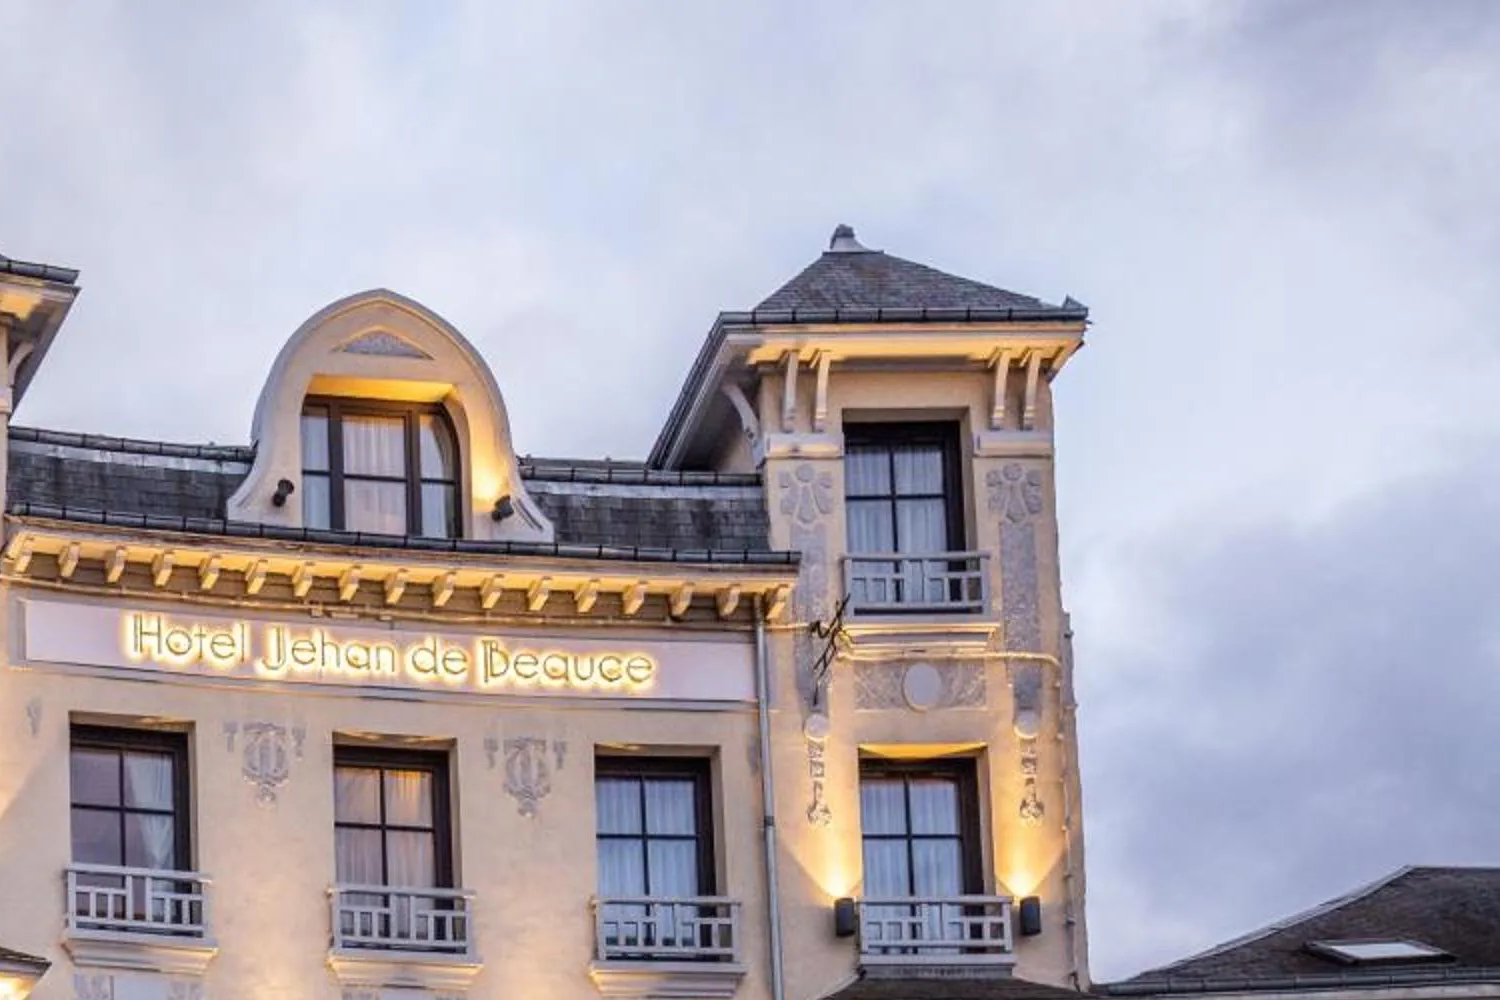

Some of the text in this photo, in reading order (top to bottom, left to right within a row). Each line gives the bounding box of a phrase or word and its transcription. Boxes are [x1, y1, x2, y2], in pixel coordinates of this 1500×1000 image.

[133, 613, 653, 683] Hotel Jehan de Beauce
